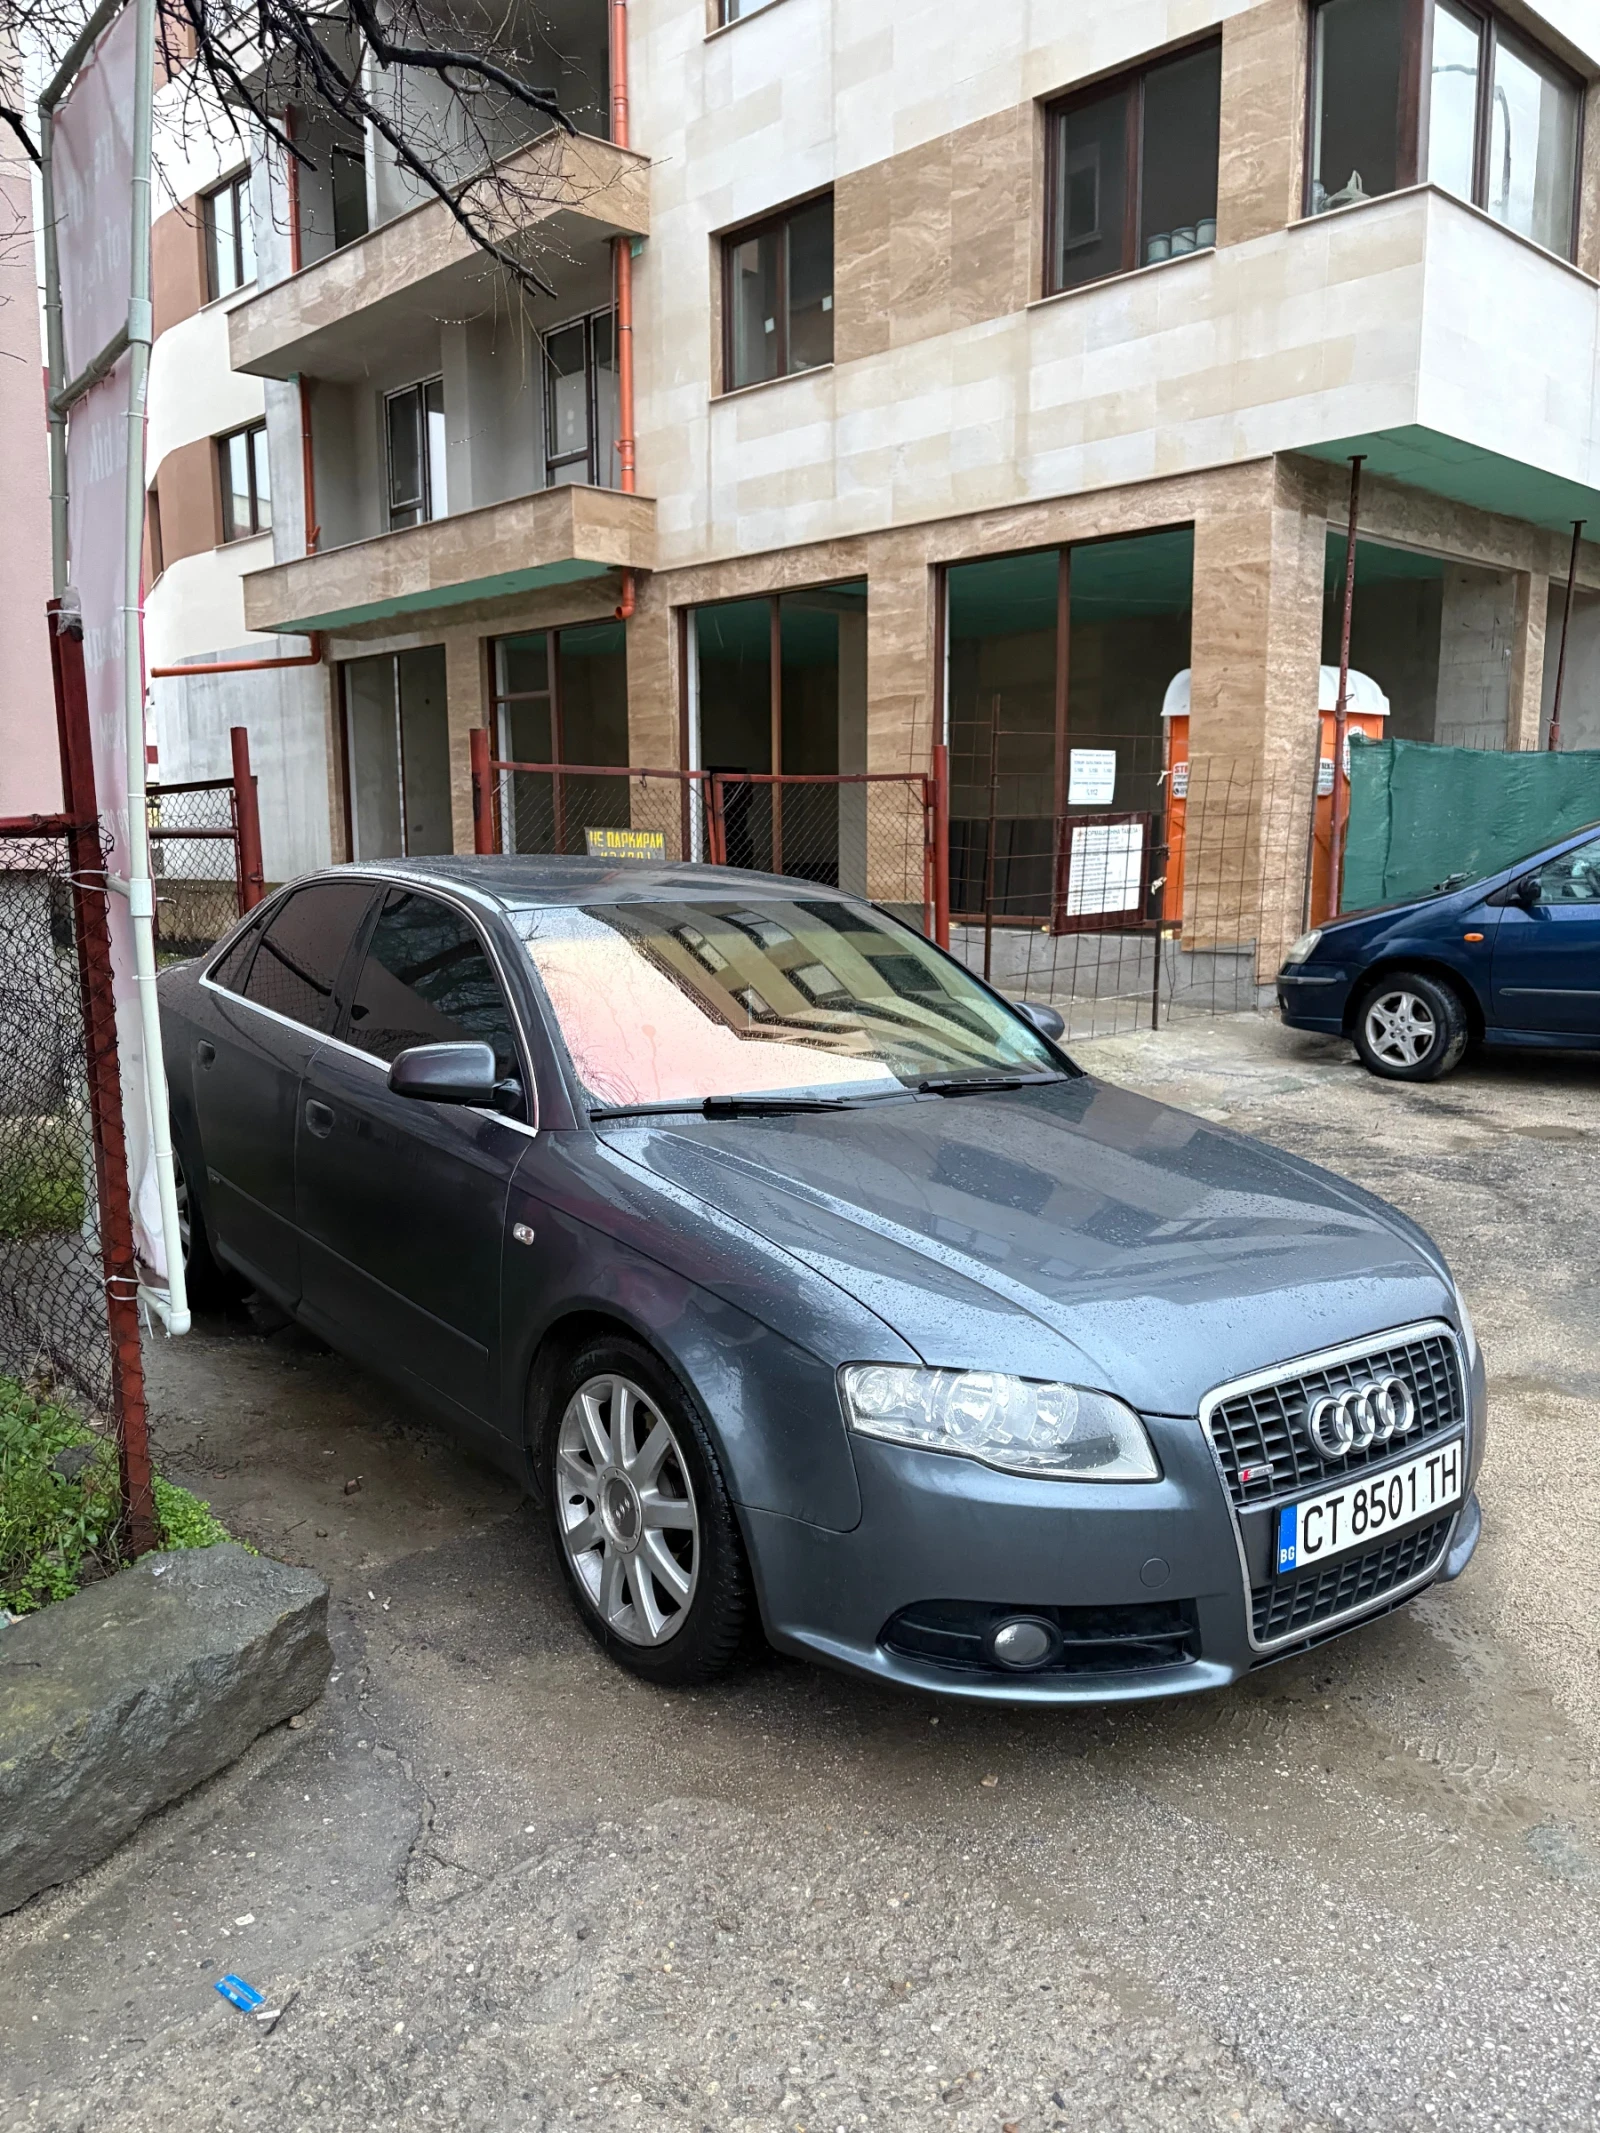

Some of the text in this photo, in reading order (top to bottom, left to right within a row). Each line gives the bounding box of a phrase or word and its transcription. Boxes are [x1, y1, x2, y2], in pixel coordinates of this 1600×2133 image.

[589, 831, 604, 848] НЕ
[1303, 1448, 1457, 1554] CT 8501 TH
[1280, 1546, 1295, 1564] BG
